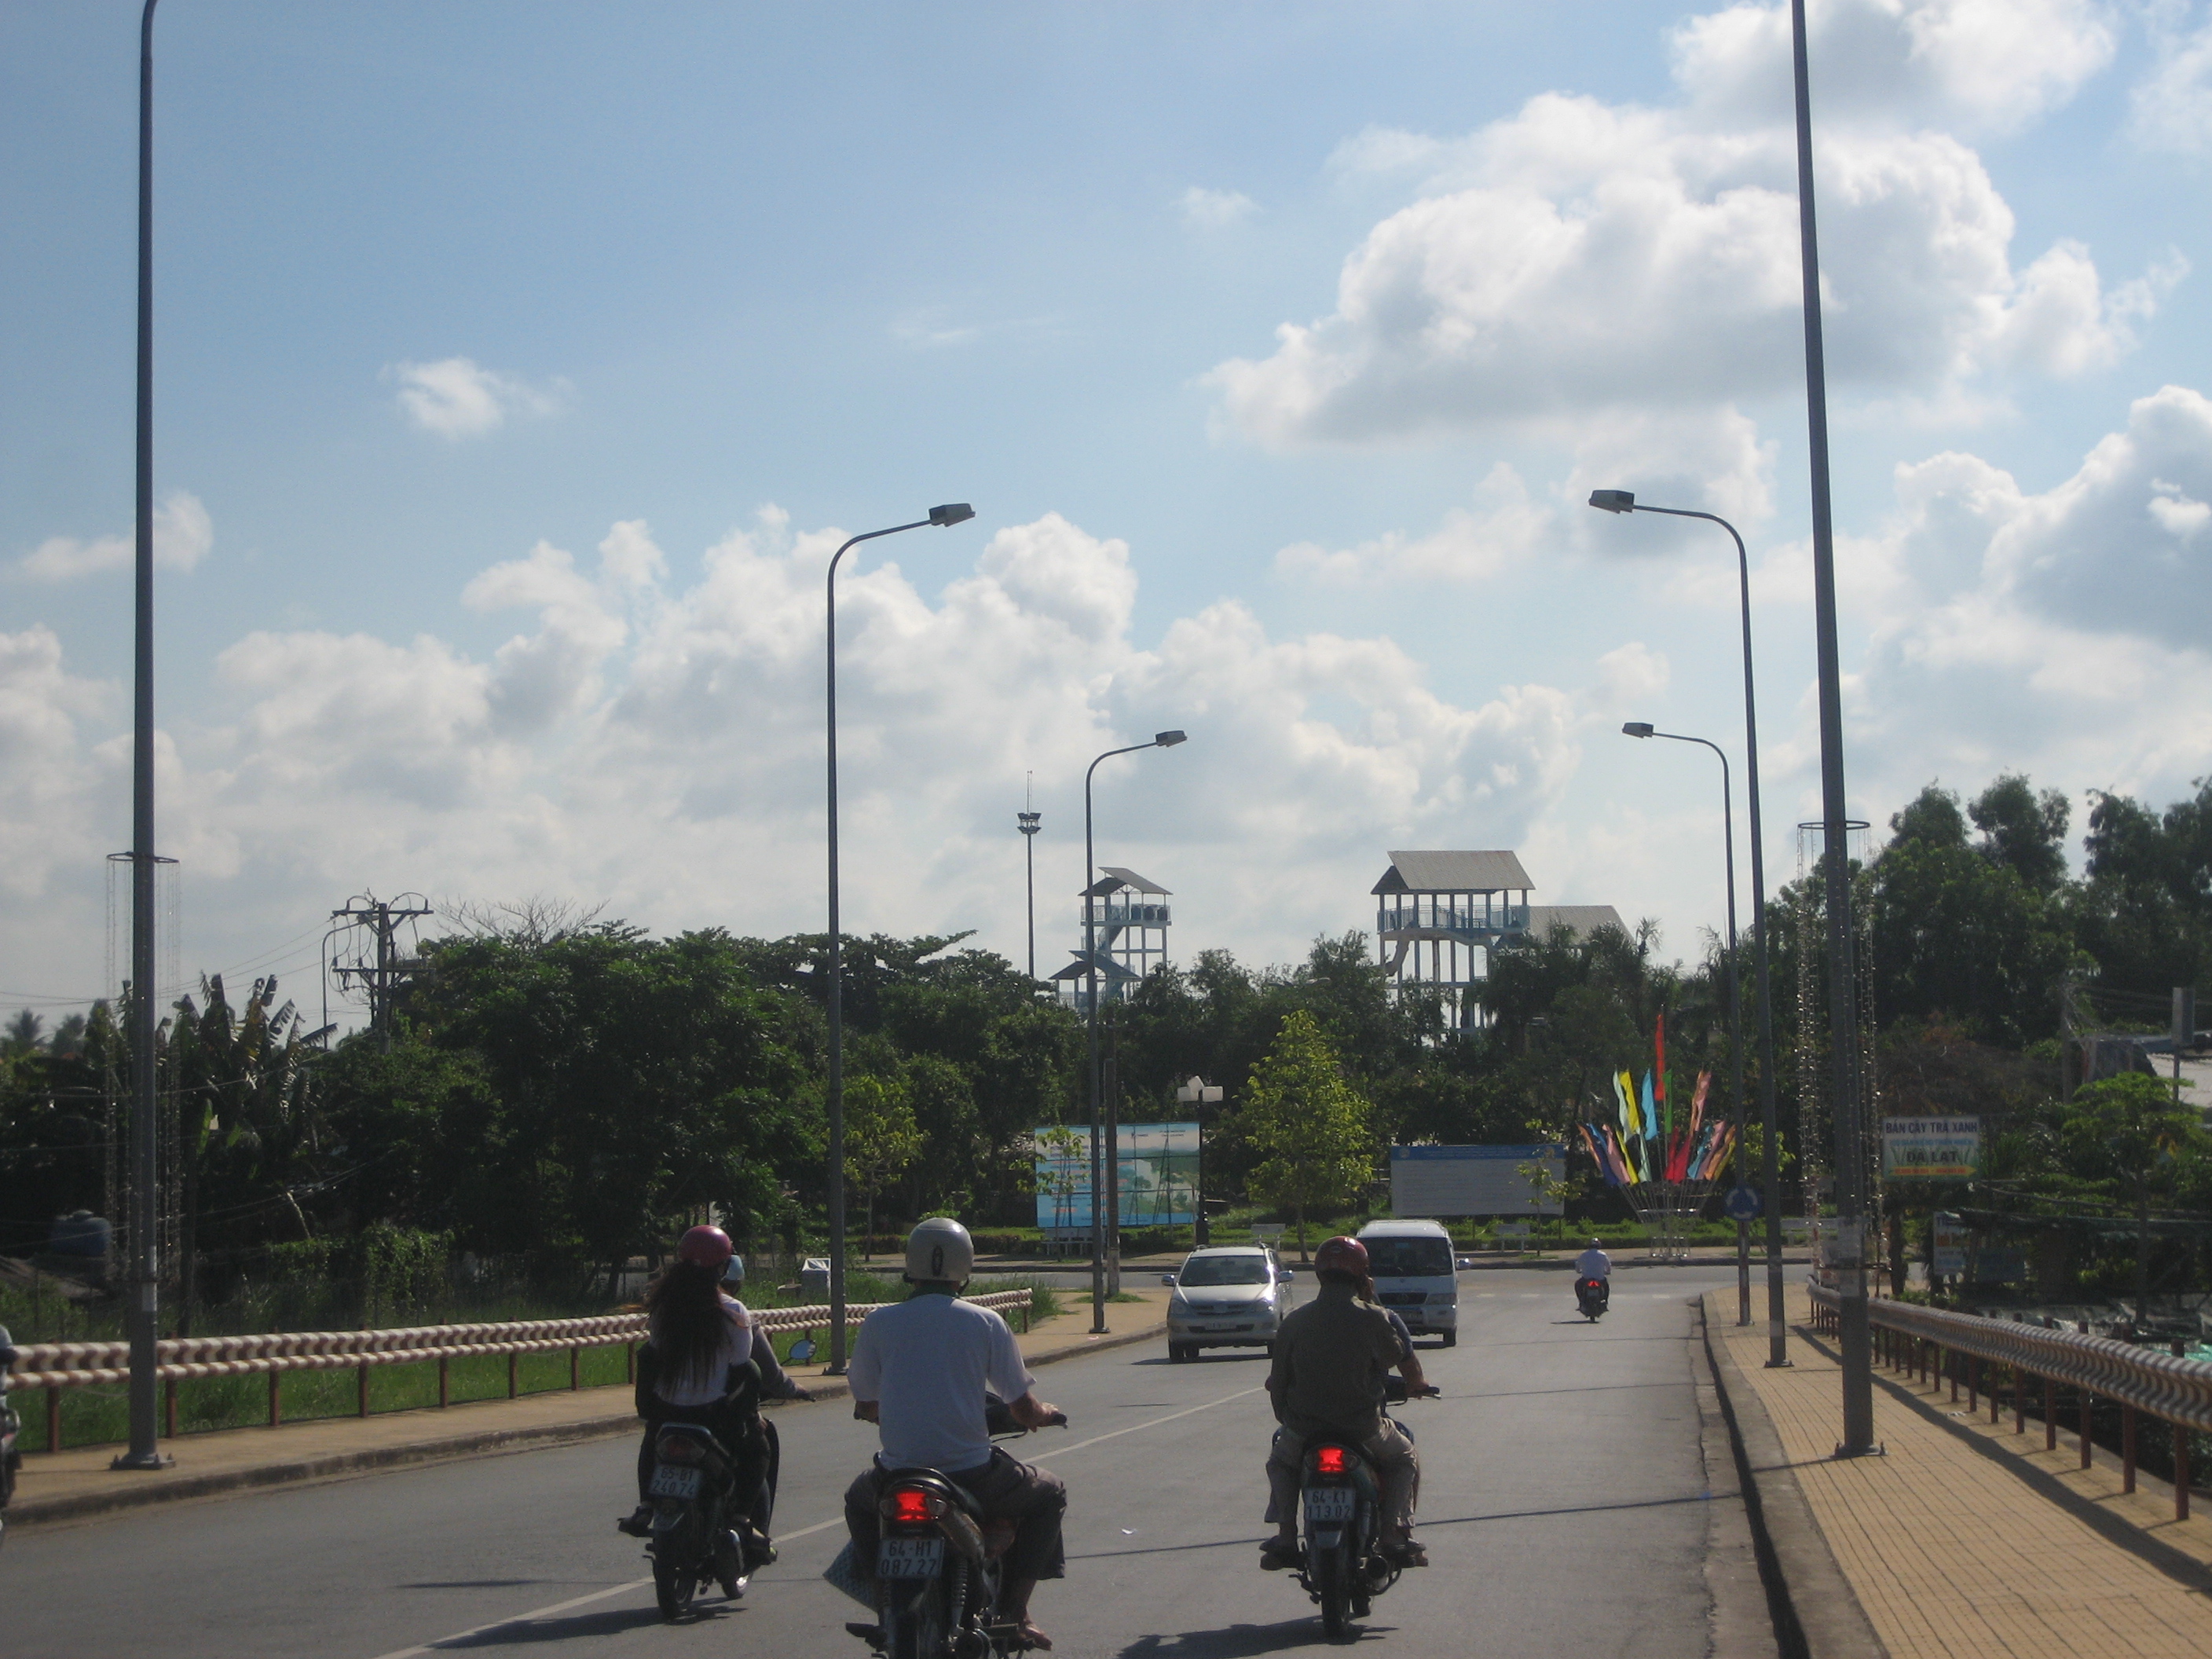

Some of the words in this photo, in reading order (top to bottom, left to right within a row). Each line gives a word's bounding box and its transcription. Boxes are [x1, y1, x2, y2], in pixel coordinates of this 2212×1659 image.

[1952, 1122, 1977, 1133] XANH
[888, 1540, 932, 1557] 64-H1
[880, 1558, 938, 1576] 087.27
